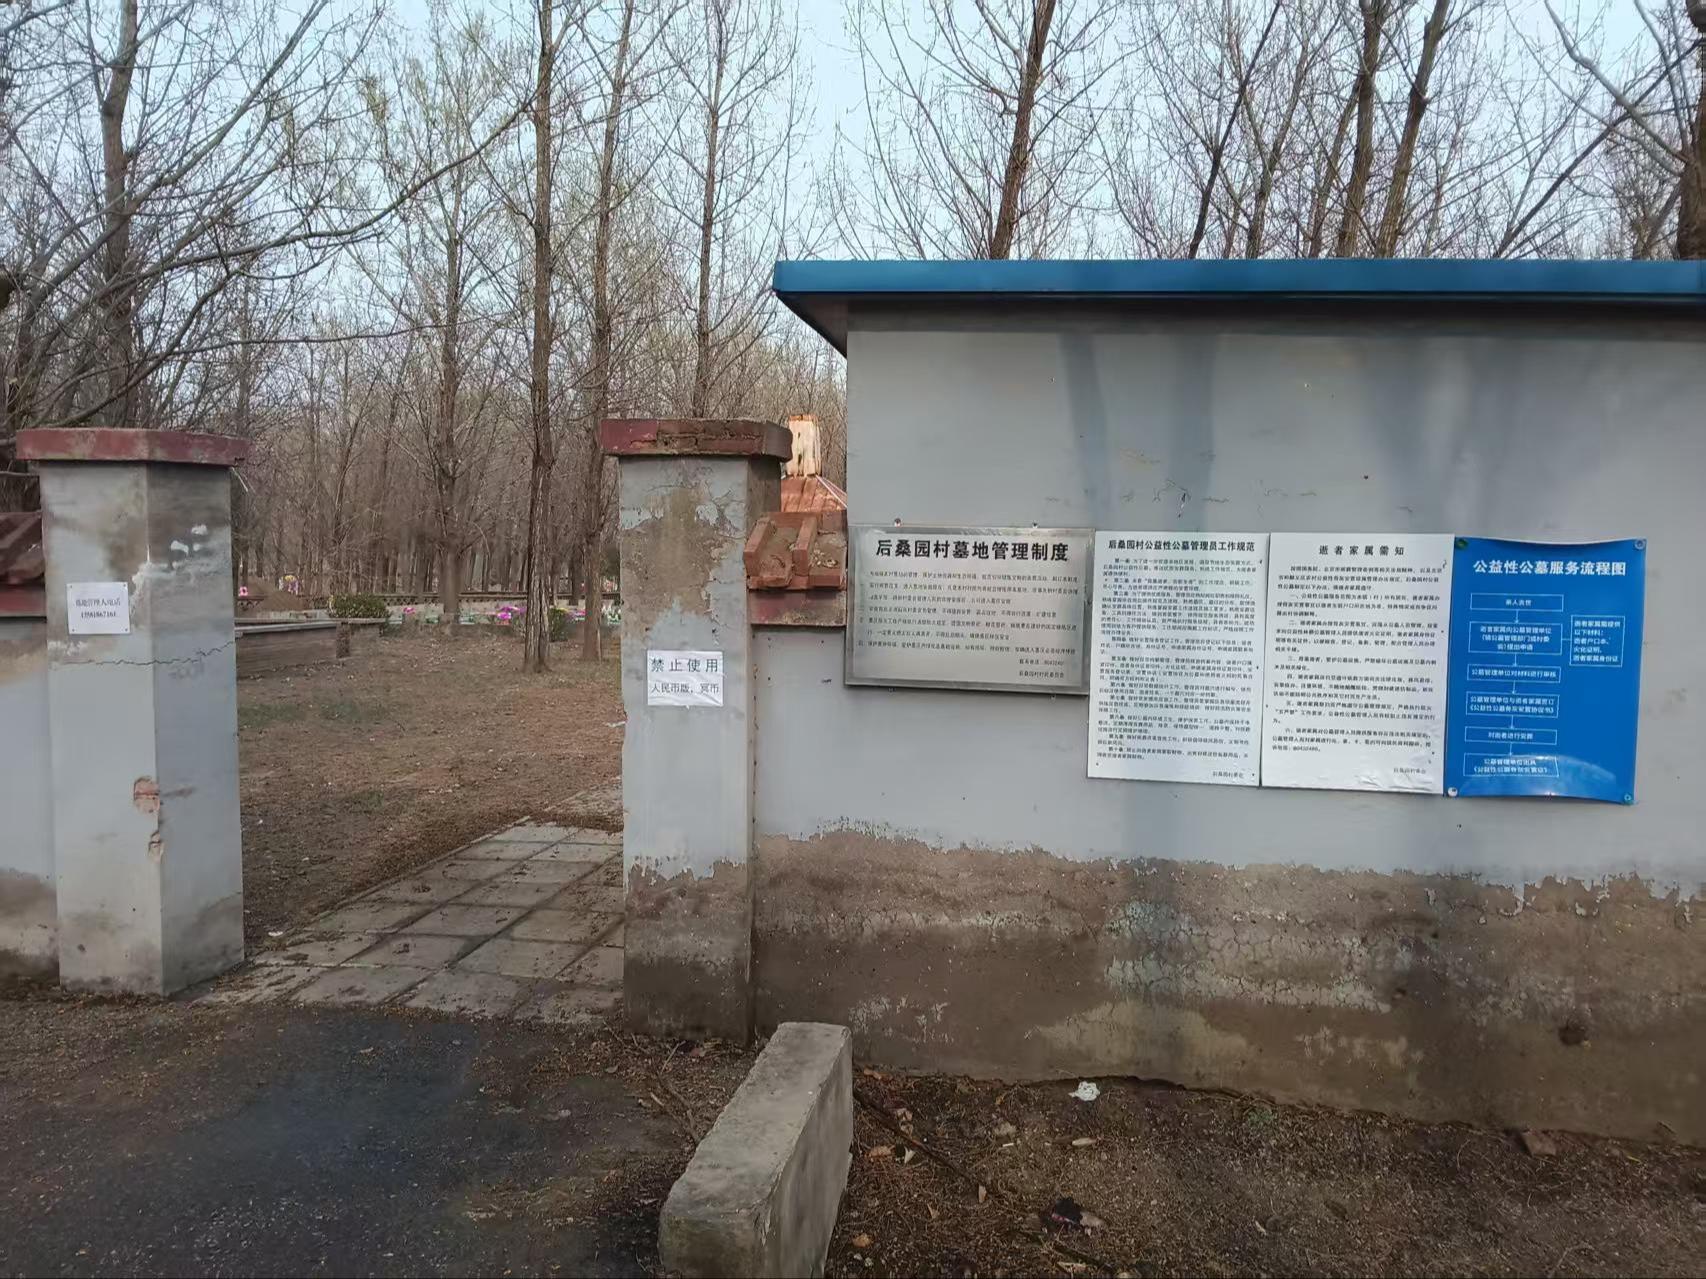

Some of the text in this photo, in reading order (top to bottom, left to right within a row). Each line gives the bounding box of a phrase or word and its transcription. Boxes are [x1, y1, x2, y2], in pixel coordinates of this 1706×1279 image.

[876, 539, 1069, 561] 后桑园村墓地管理制度
[1108, 540, 1255, 552] 后桑园村公益性公墓管理员工作规范
[1319, 545, 1404, 556] 逝者家属需知
[1473, 560, 1626, 576] 公益性公墓服务流程图
[651, 658, 718, 672] 禁止使用
